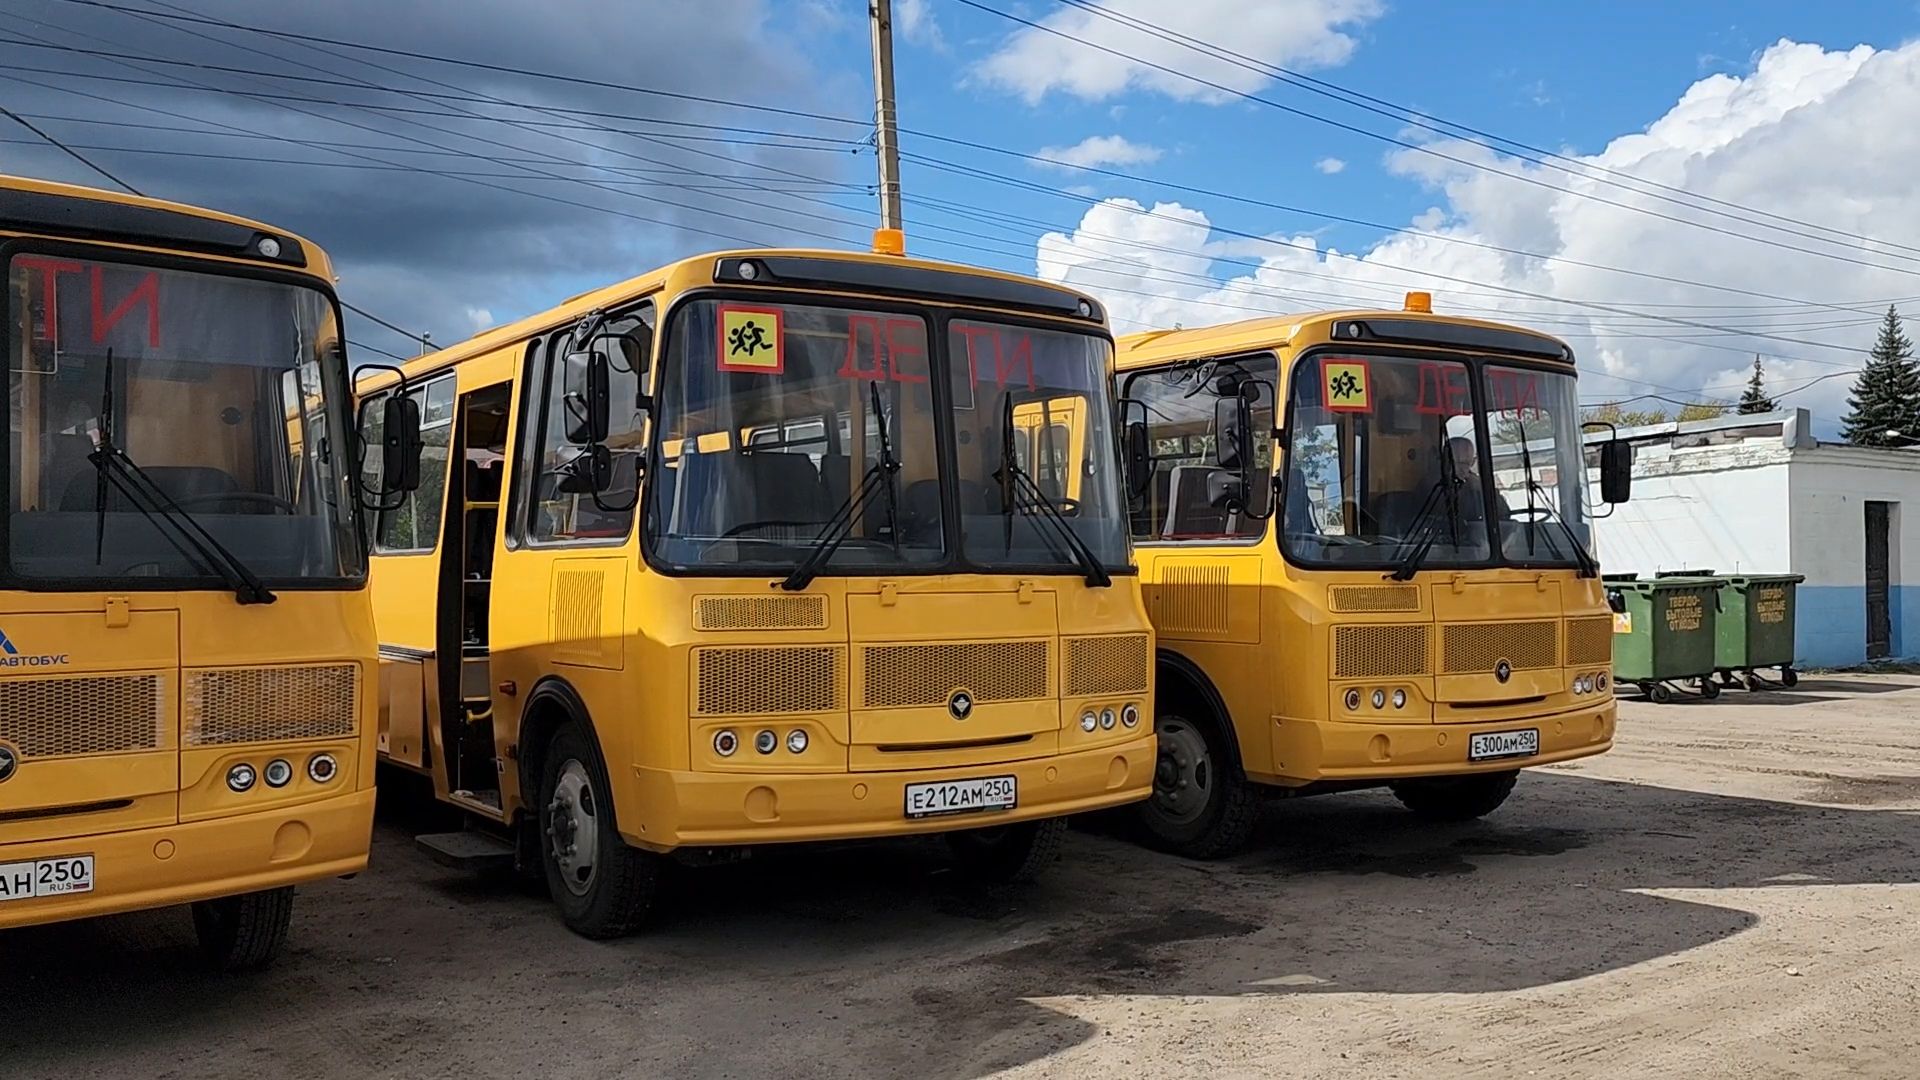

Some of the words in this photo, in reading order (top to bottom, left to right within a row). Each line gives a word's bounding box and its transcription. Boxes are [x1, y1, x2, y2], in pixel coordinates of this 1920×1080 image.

[1666, 607, 1702, 620] БЫТОВЫЕ
[0, 654, 70, 667] АВТОБУС
[1518, 732, 1535, 746] 250
[985, 780, 1010, 797] 250
[39, 859, 85, 884] 250
[49, 882, 72, 892] RUS
